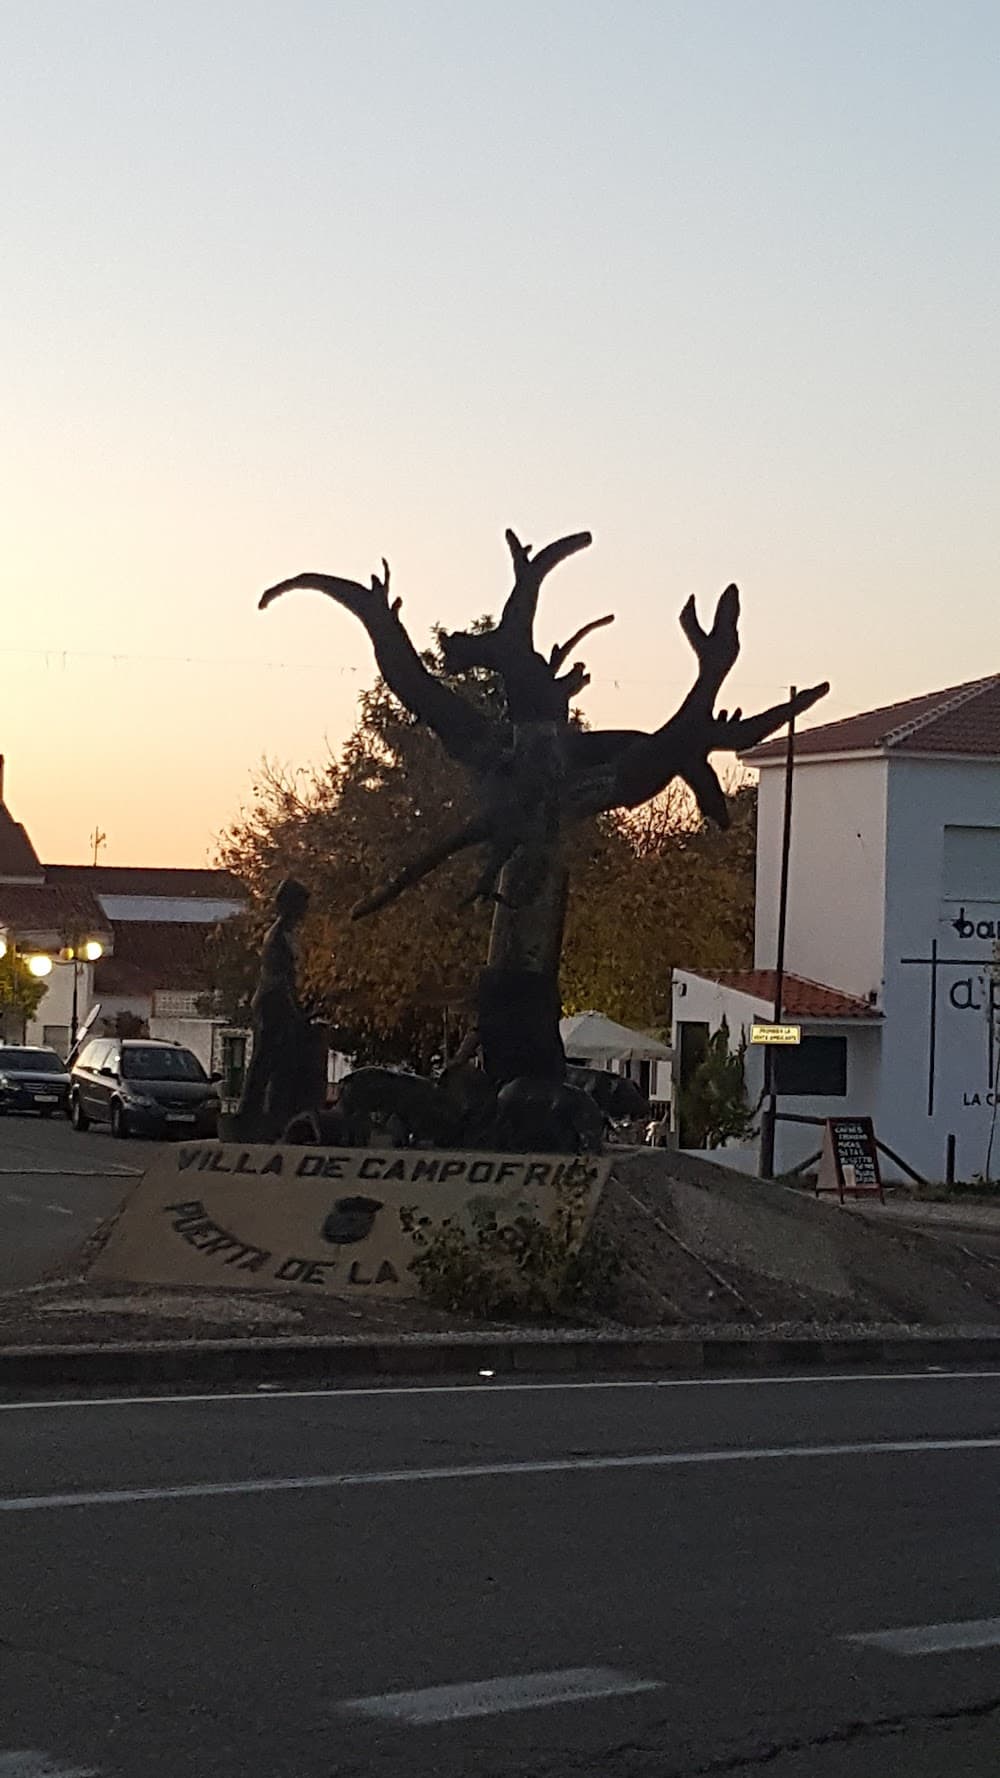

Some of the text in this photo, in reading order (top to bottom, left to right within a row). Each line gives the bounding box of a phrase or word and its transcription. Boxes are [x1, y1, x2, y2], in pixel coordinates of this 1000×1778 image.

[963, 1092, 981, 1106] LA
[179, 1148, 282, 1175] VILLA
[296, 1154, 350, 1178] DE
[162, 1199, 399, 1285] PUERTA DE LA
